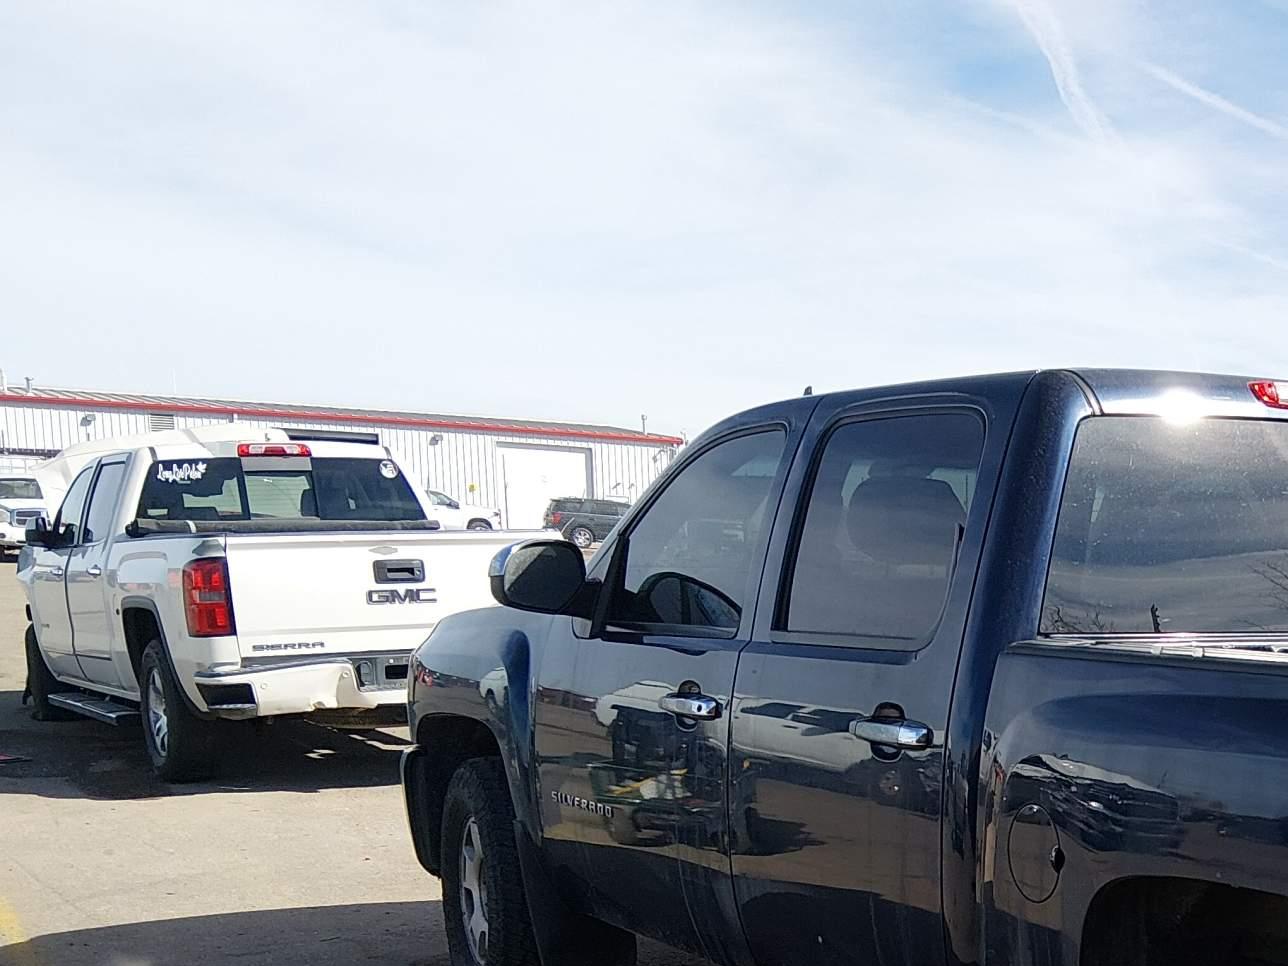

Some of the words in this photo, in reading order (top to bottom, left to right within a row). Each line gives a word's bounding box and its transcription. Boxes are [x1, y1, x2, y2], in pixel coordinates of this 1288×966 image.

[366, 588, 437, 605] GMC
[252, 641, 325, 651] SIERRA
[551, 791, 614, 818] SILVERADO
